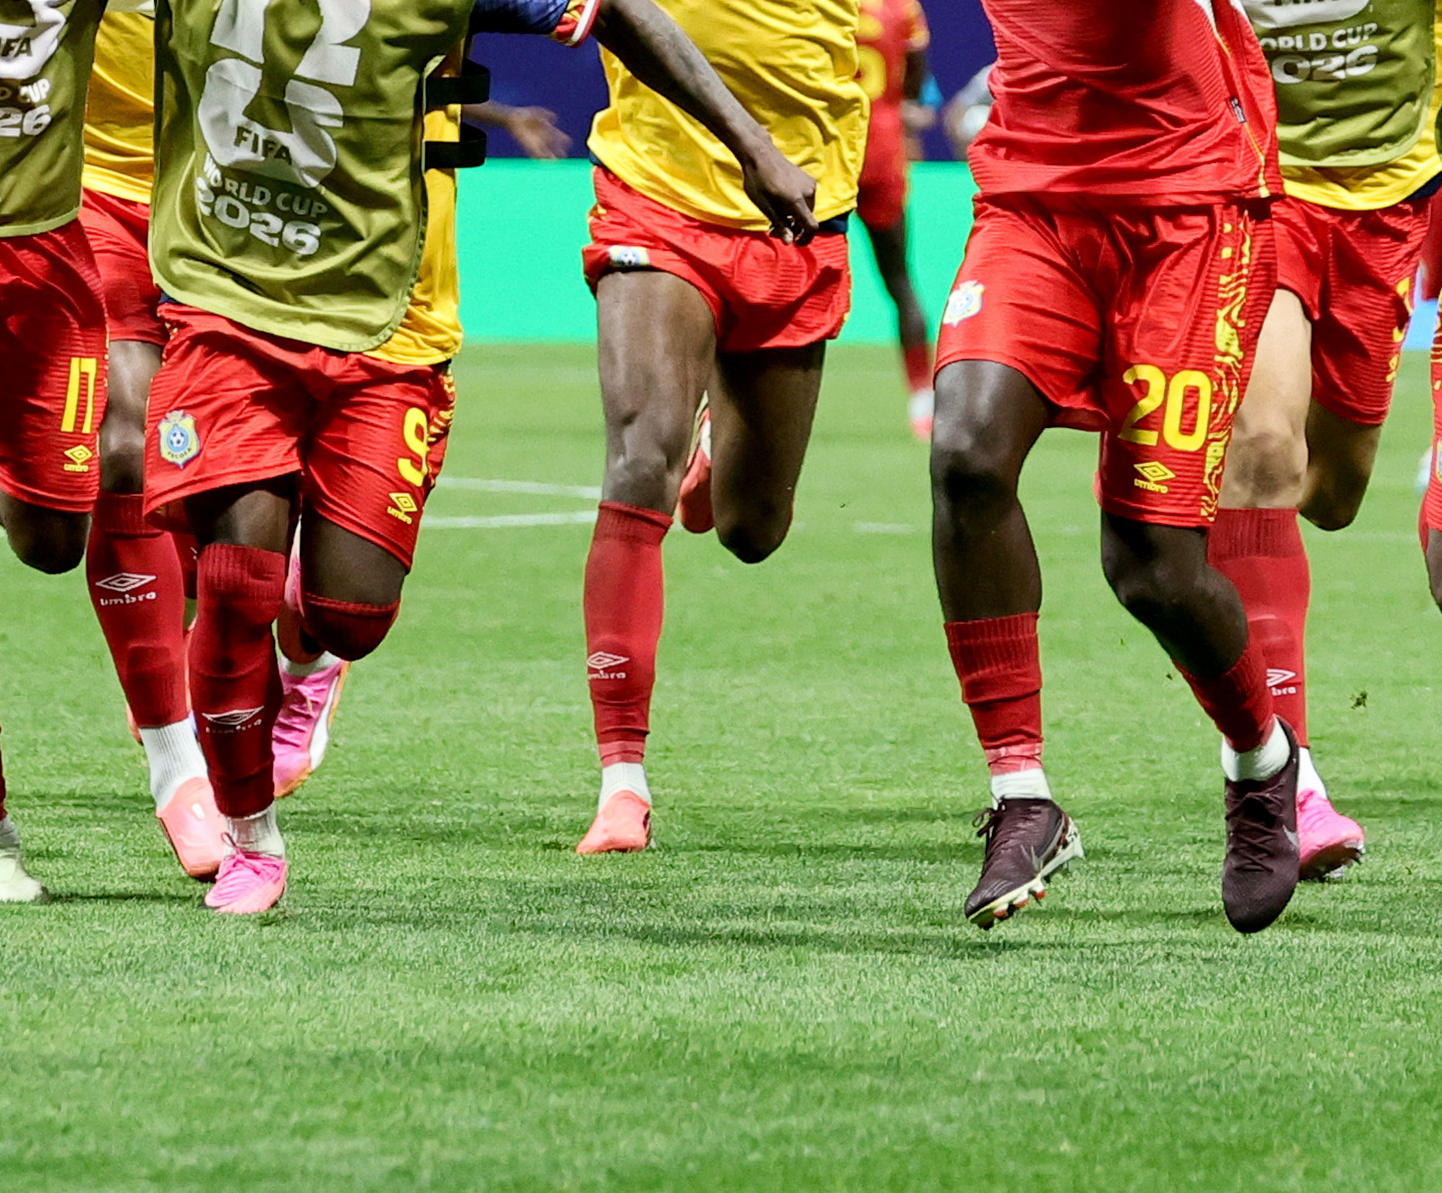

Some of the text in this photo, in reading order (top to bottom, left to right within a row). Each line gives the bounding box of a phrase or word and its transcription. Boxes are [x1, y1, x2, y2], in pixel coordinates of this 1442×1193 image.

[1259, 22, 1378, 51] ORLD CUP
[1271, 44, 1379, 84] 026
[16, 77, 52, 104] CUP
[233, 125, 294, 166] FIFA
[202, 150, 329, 219] WORLD CUP
[195, 175, 322, 256] 2026
[60, 356, 98, 435] 17
[1117, 363, 1212, 452] 20
[397, 407, 430, 487] 9
[99, 591, 158, 606] umbro
[1271, 687, 1297, 696] bro
